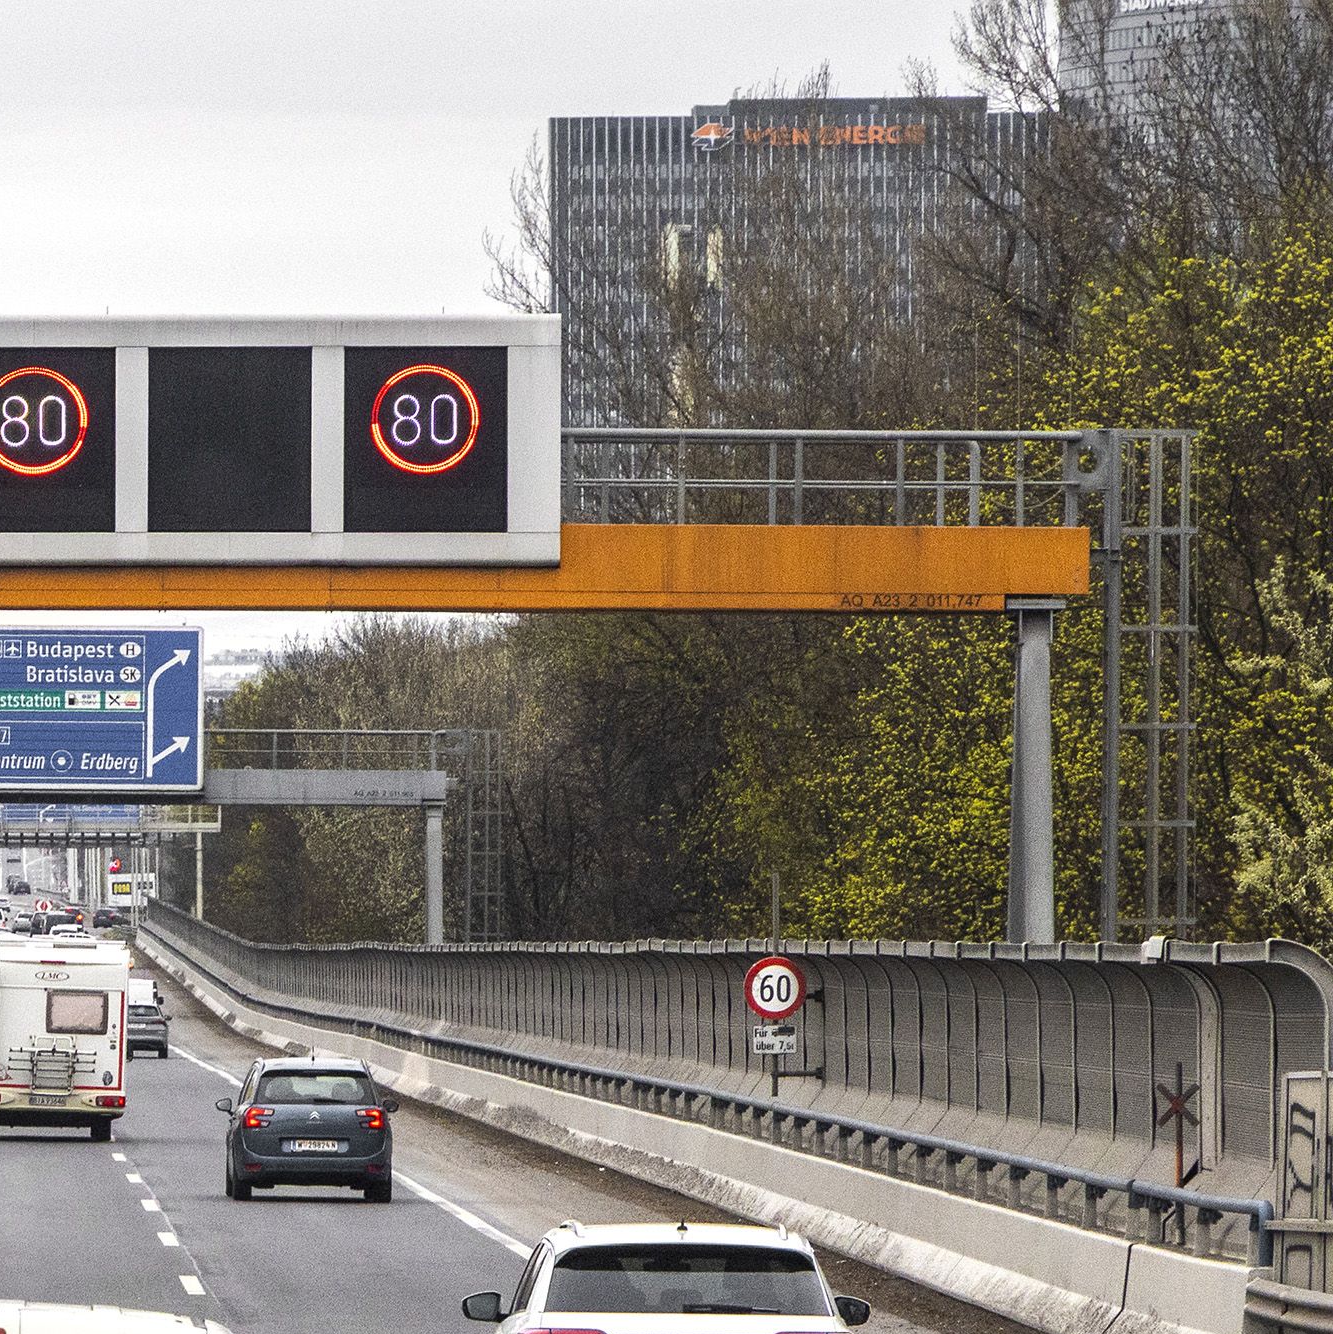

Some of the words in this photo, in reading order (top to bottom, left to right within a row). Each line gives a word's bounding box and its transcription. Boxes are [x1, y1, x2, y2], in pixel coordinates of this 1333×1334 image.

[0, 395, 67, 447] 80
[392, 393, 458, 446] 80
[873, 594, 900, 607] A23
[27, 641, 114, 661] Budapest
[126, 644, 135, 656] H
[27, 665, 114, 683] Bratislava
[123, 669, 137, 681] SK
[80, 752, 139, 774] Erdberg
[760, 974, 791, 1003] 60
